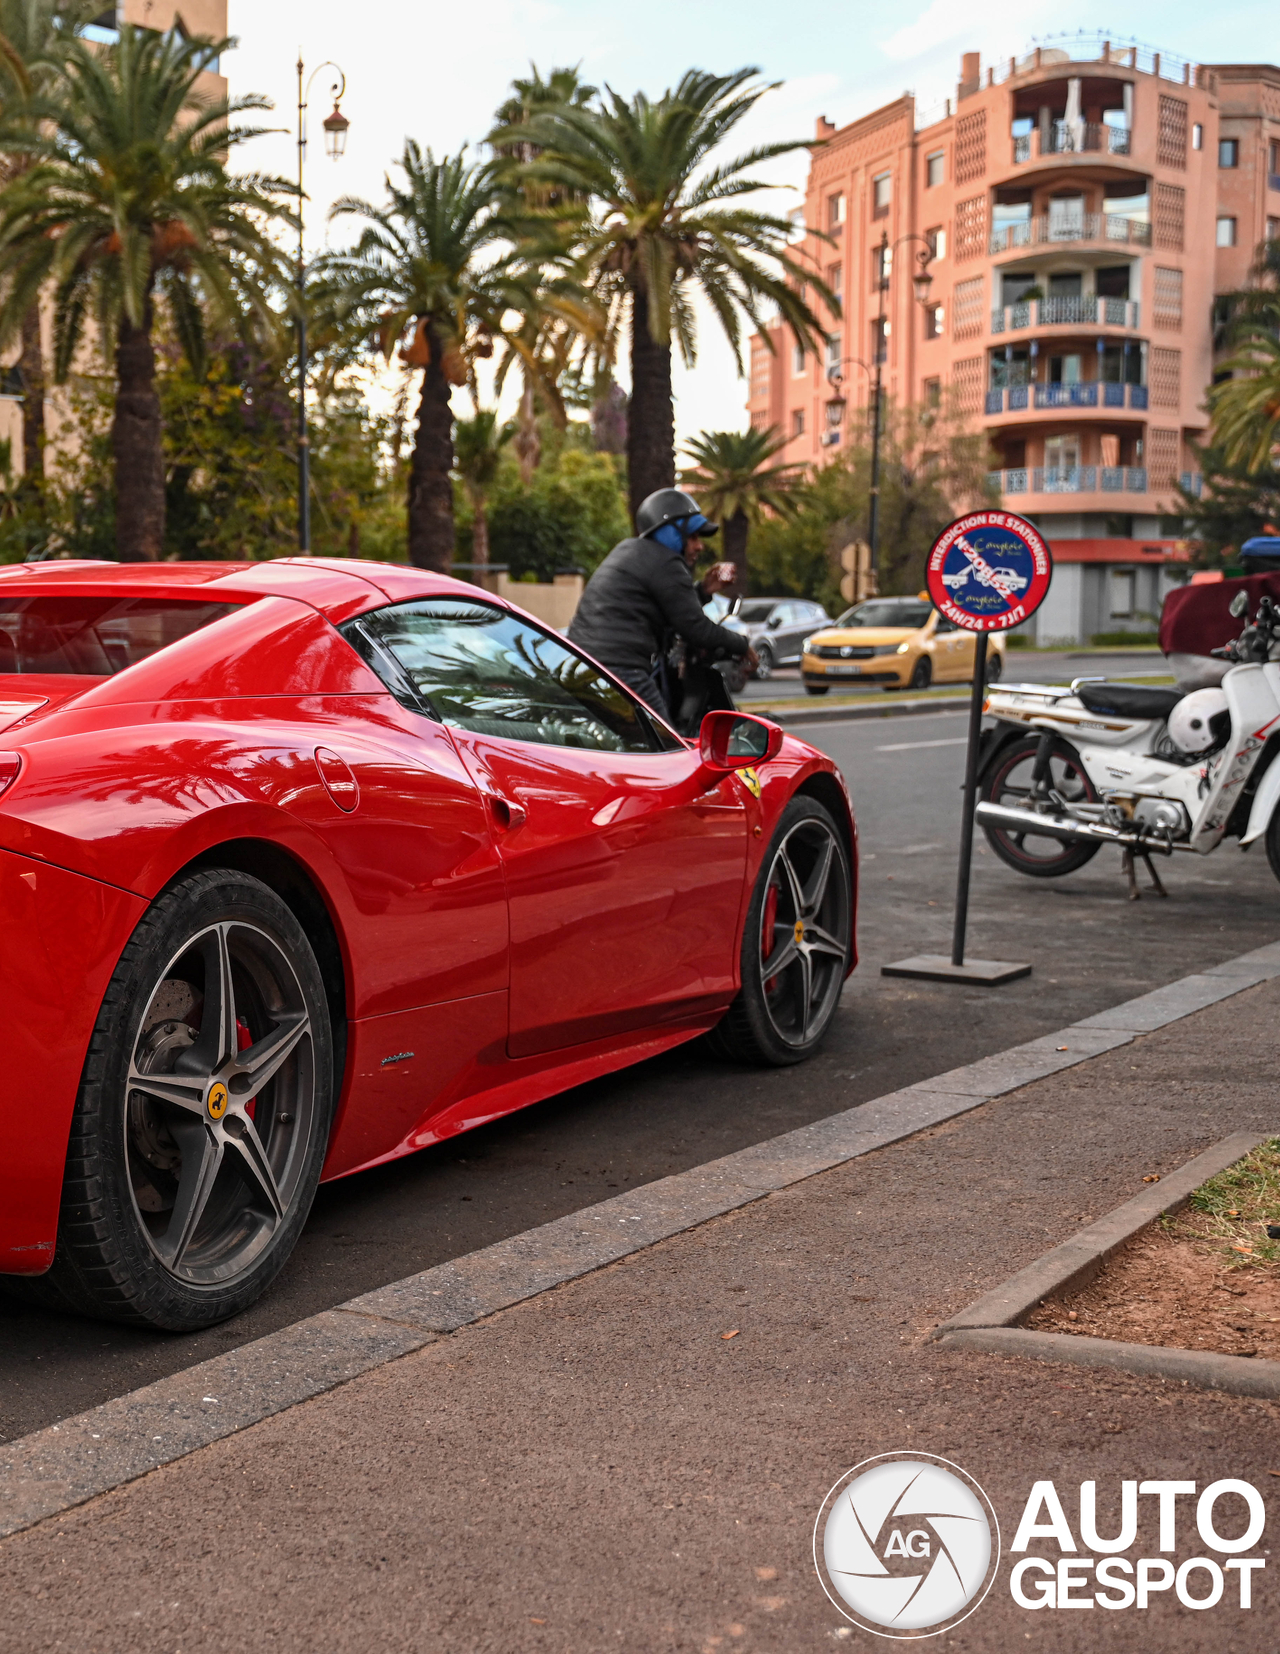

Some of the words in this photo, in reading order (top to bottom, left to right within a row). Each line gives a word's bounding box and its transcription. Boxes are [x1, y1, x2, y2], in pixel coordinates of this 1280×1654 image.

[930, 514, 987, 571] INTERDICTION
[988, 513, 1006, 525] DE
[1006, 517, 1048, 576] STATIONNER
[940, 600, 984, 630] 24H/24
[998, 605, 1025, 627] 7J/7
